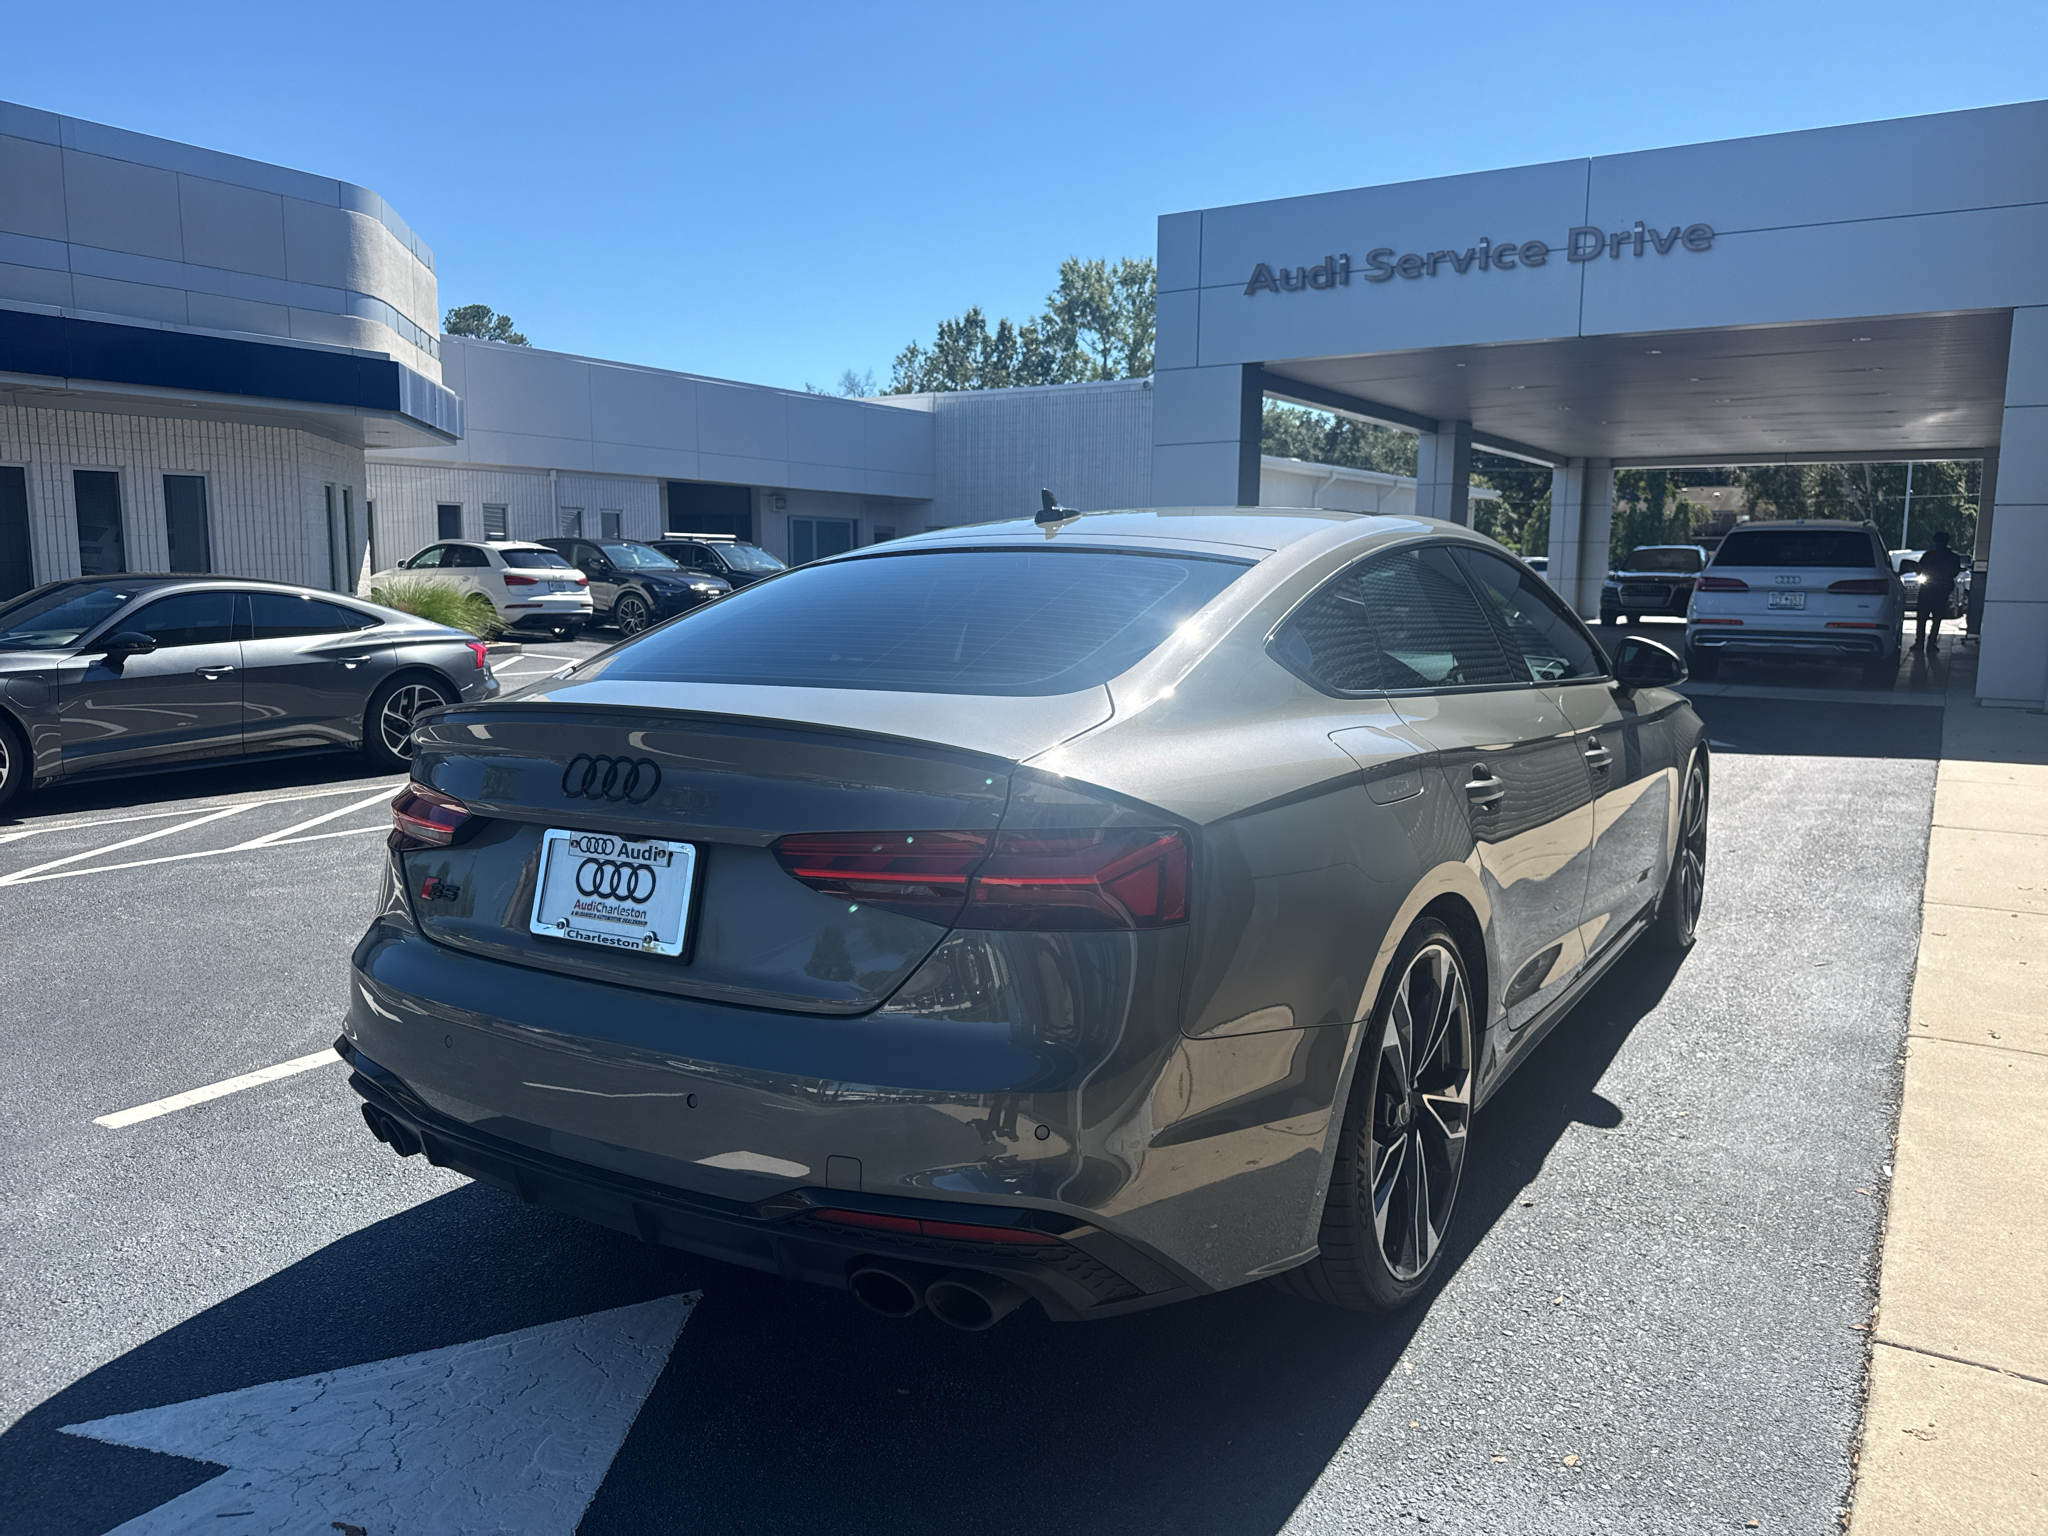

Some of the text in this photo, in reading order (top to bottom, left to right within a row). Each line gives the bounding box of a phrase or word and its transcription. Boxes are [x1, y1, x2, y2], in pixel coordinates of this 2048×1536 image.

[1243, 220, 1714, 296] Audi Service Drive
[617, 843, 659, 861] Audi
[573, 899, 647, 919] AudiCharleston
[566, 929, 639, 949] Charleston
